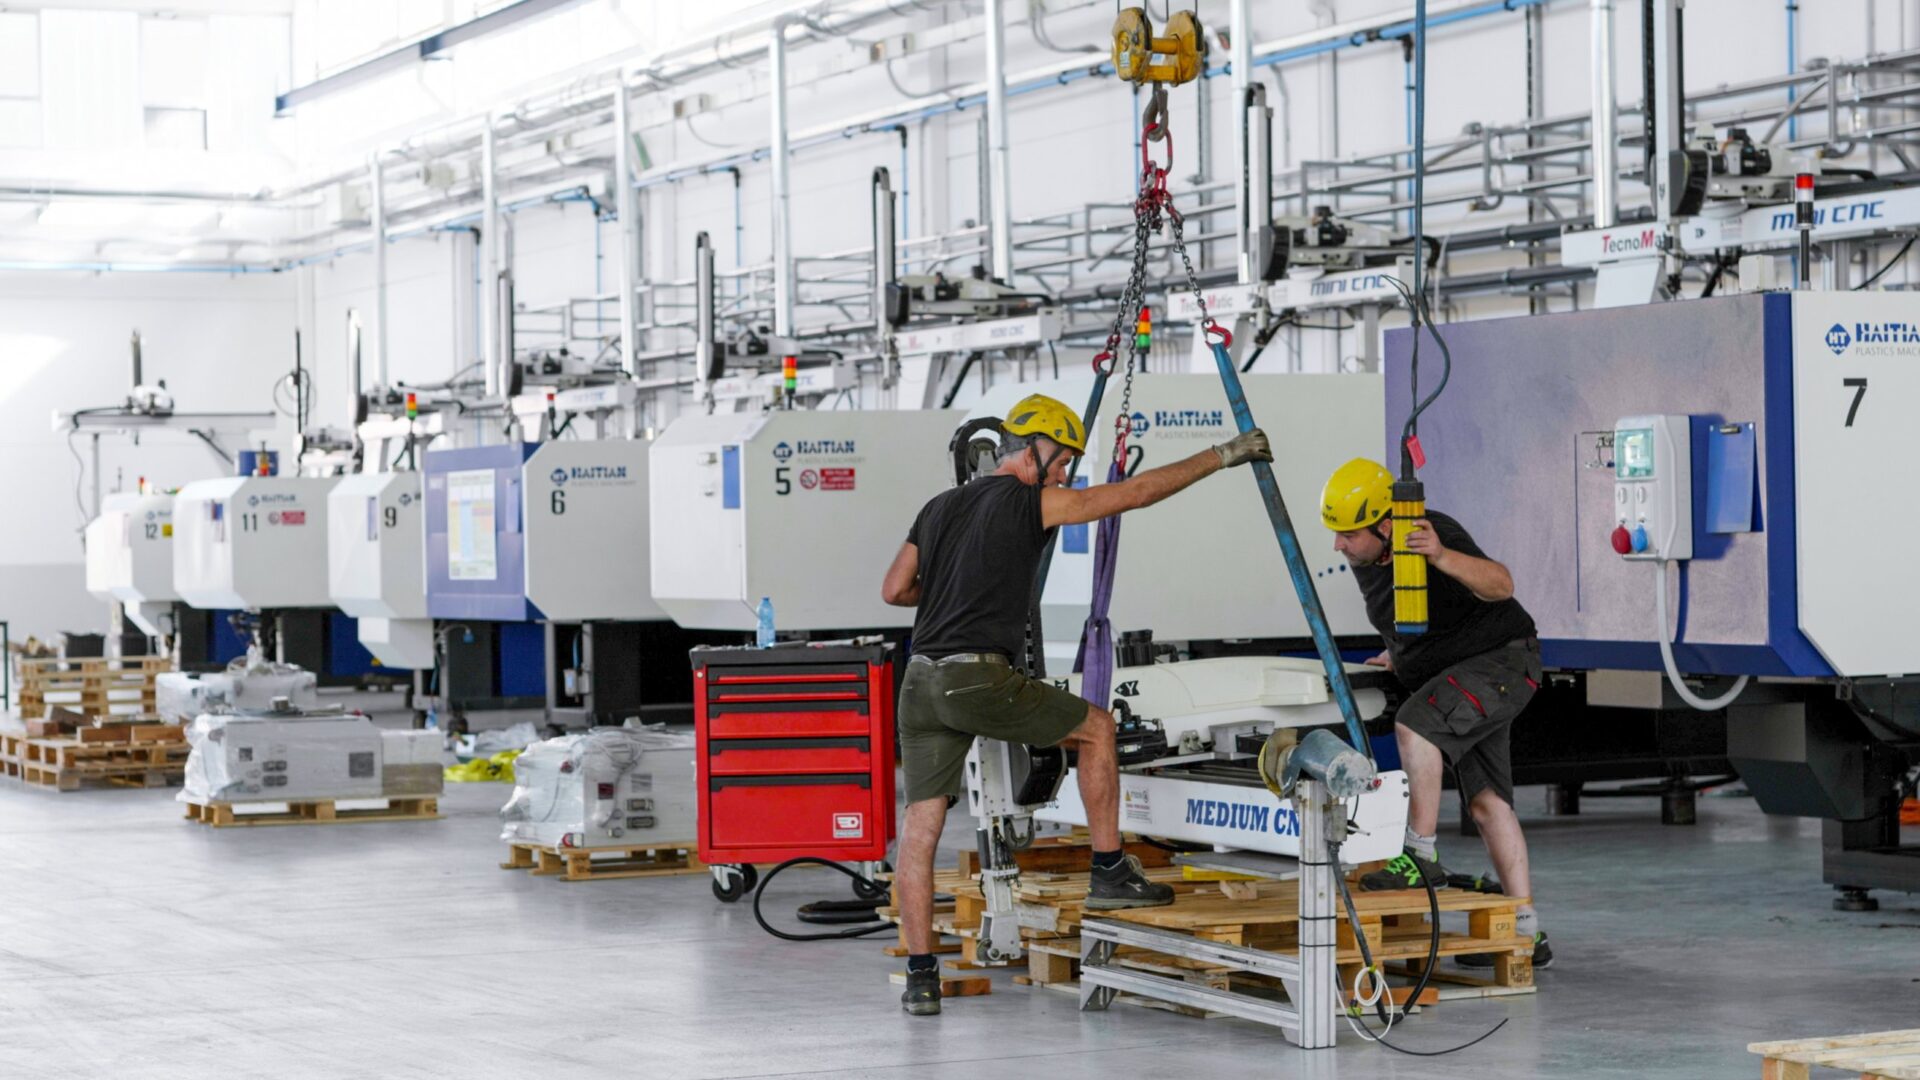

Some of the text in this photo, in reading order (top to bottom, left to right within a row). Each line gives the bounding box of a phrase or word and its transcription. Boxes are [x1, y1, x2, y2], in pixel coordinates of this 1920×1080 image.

[1856, 323, 1920, 342] HAITIA
[1856, 346, 1920, 356] PLASTICS MAC
[1843, 378, 1867, 427] 7
[1155, 410, 1222, 426] HAITIAN
[797, 441, 854, 453] HAITIAN
[571, 466, 626, 479] HAITIAN
[776, 467, 791, 495] 5
[551, 490, 565, 515] 6
[243, 513, 257, 532] 11
[384, 507, 397, 528] 9
[145, 523, 158, 540] 12
[1125, 682, 1135, 695] Y
[1185, 799, 1270, 833] MEDIUM
[1273, 808, 1300, 837] CN
